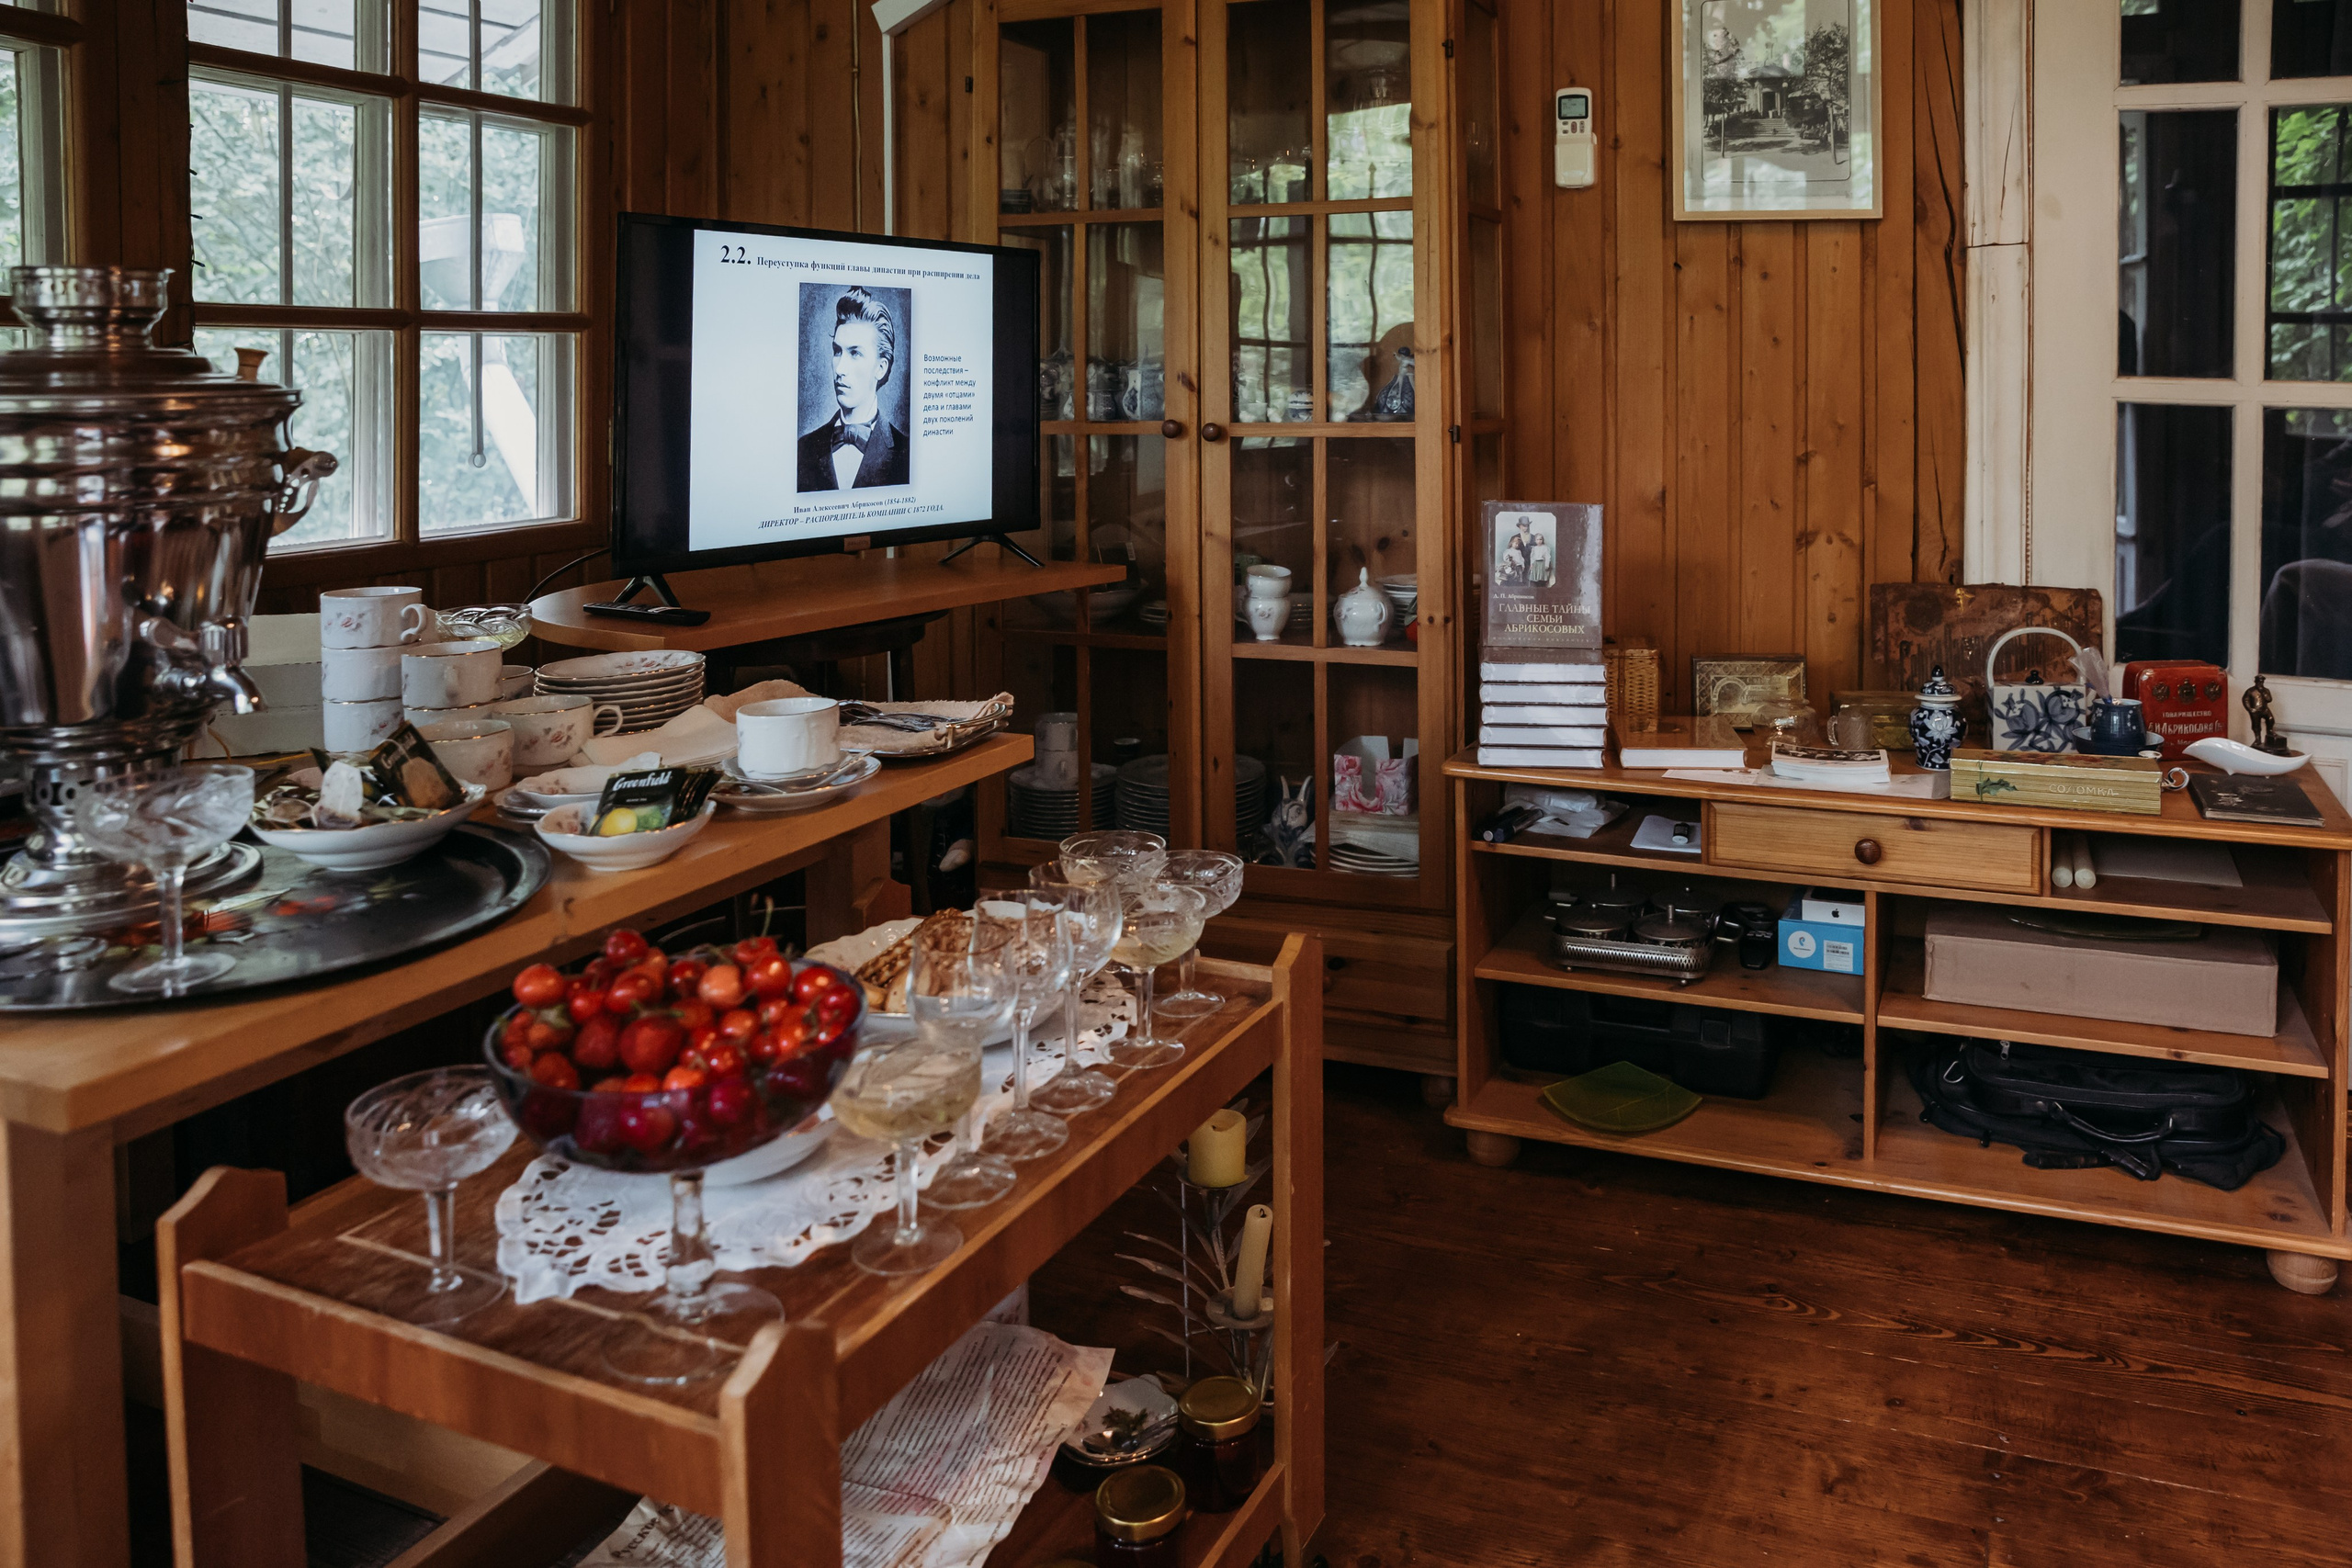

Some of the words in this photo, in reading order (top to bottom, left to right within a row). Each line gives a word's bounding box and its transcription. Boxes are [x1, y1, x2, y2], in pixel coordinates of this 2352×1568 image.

[720, 244, 752, 265] 2.2.
[757, 257, 808, 268] Переуступка
[810, 261, 845, 271] функций
[847, 265, 870, 273] главы
[872, 266, 906, 275] династии
[908, 269, 921, 277] при
[922, 270, 964, 279] расширении
[923, 354, 962, 362] Возможные
[923, 378, 954, 388] конфликт
[955, 379, 976, 388] между
[923, 404, 939, 412] дела
[939, 414, 974, 423] поколений
[923, 429, 954, 437] династии
[812, 503, 849, 512] Алексеевич
[851, 500, 883, 509] Абрикосов
[884, 496, 916, 506] (1854-1882)
[758, 518, 799, 529] ДИРЕКТОР
[805, 511, 865, 524] РАСПОРЯДИТЕЛЬ
[866, 507, 906, 518] КОМПАНИИ
[912, 505, 925, 513] 1872
[1498, 604, 1550, 613] ГЛАВНЫЕ
[1552, 603, 1591, 615] ТАЙНЫ
[1526, 614, 1563, 624] СЕМЬИ
[1505, 624, 1585, 635] АБРИКОСОВЫХ
[613, 771, 673, 791] Greenfield
[2049, 784, 2115, 796] СОЛОМКА
